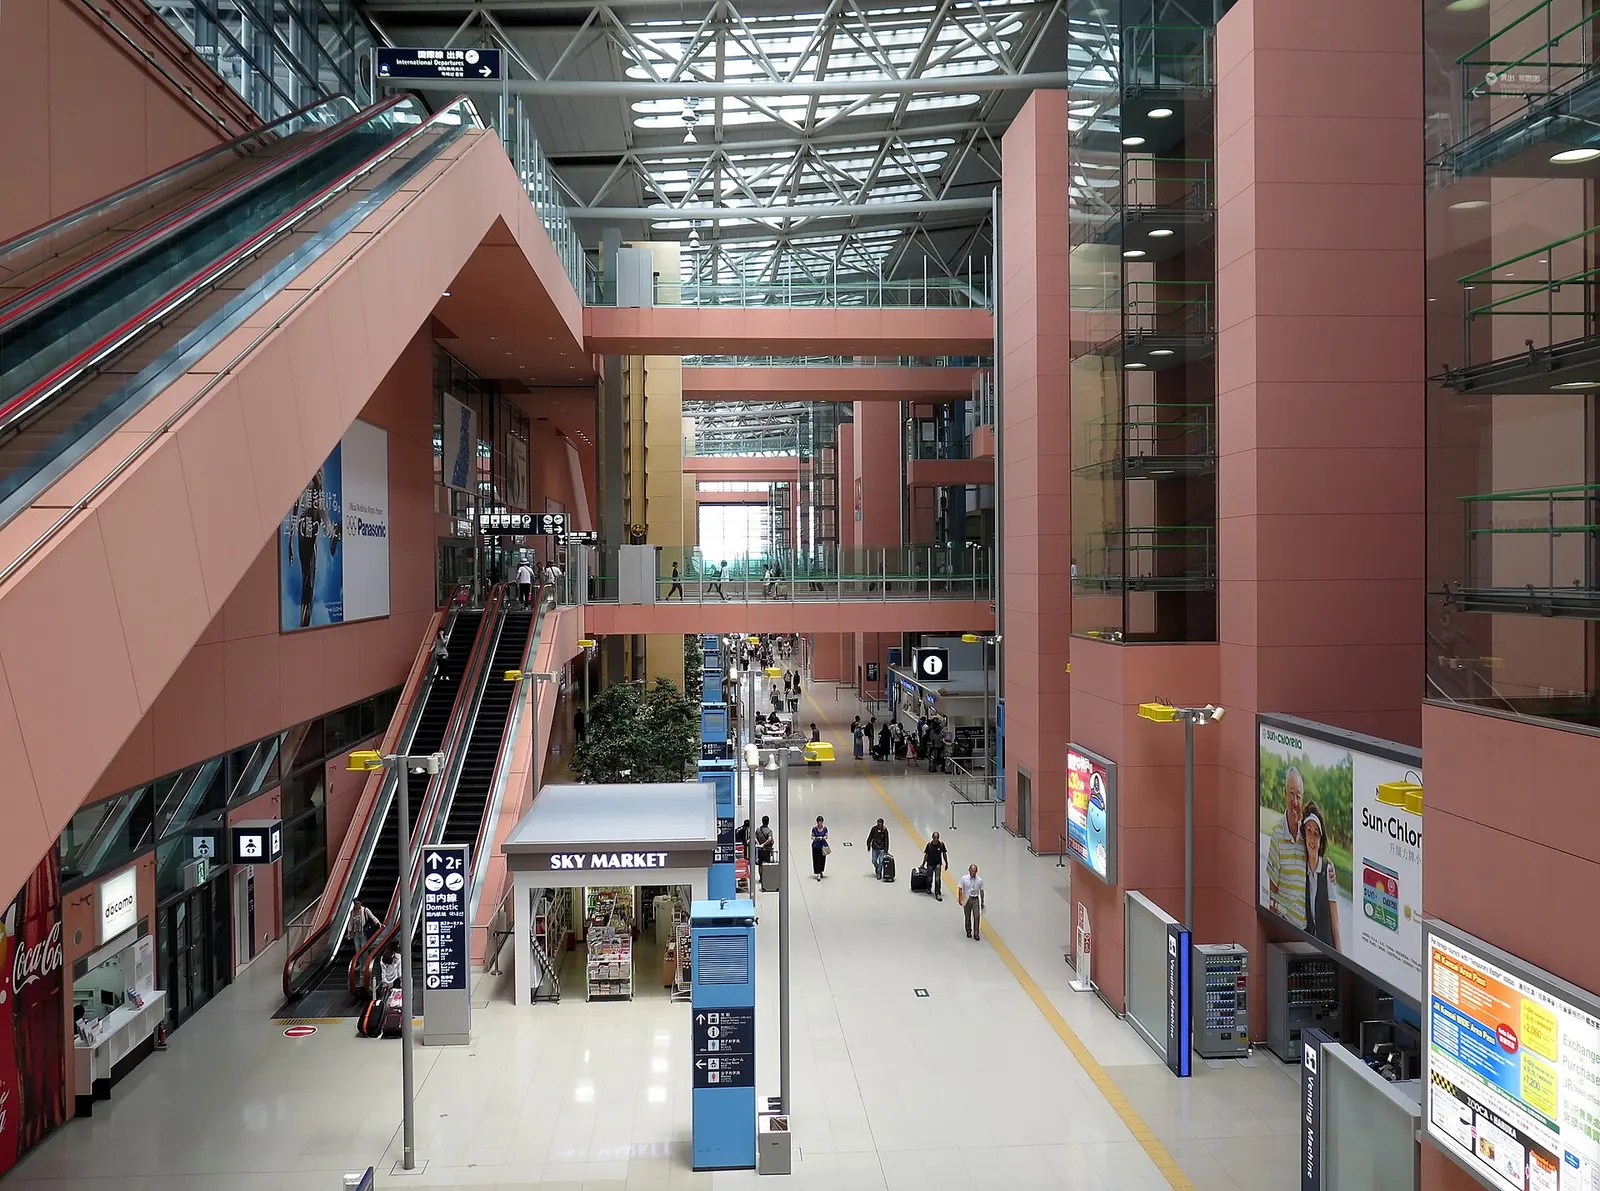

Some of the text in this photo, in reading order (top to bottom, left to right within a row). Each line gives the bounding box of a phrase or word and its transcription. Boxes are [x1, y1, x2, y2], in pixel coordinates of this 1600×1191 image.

[358, 517, 386, 538] Panasonic
[445, 856, 462, 870] 2F
[550, 852, 668, 869] SKY MARKET
[105, 895, 133, 918] docomo
[426, 893, 457, 903] 国内線
[1434, 951, 1487, 988] JR Kansai Area Pass
[1440, 1004, 1457, 1022] Kansai
[1470, 1024, 1483, 1038] Area
[1483, 1030, 1496, 1046] Pass
[1563, 1034, 1600, 1064] Exchange
[1562, 1055, 1600, 1086] Purchase
[1306, 1076, 1314, 1124] Vending
